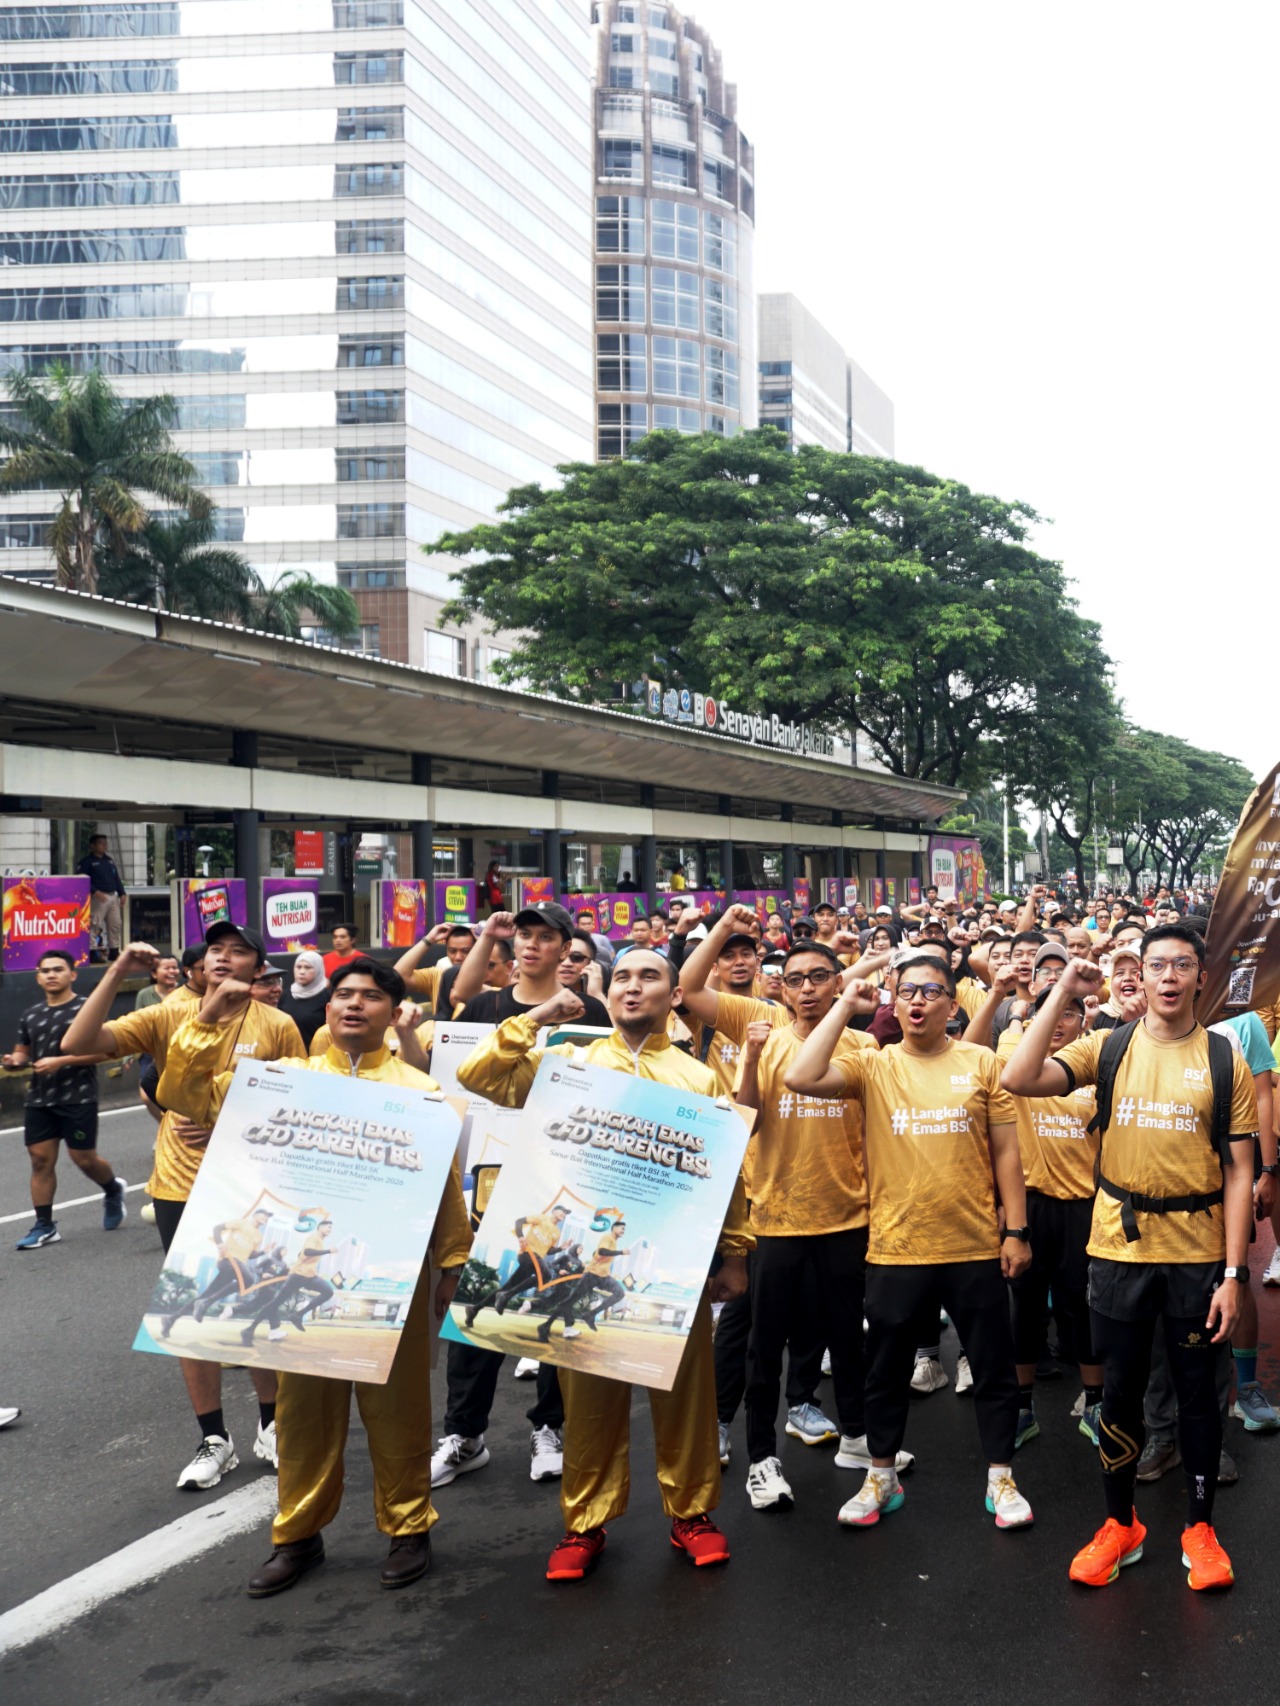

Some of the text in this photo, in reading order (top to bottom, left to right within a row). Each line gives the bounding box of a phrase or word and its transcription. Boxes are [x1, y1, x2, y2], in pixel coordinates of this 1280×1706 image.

[719, 699, 770, 743] Senayan
[771, 713, 799, 747] Bank
[799, 722, 834, 756] Jakarta
[275, 899, 308, 914] TEH BUAH
[14, 909, 76, 937] NutriSari
[271, 909, 312, 928] NUTRISARI
[234, 1042, 256, 1055] BSI
[950, 1074, 971, 1085] BSI
[1184, 1067, 1205, 1081] BSI
[383, 1100, 406, 1115] BSI
[676, 1105, 699, 1121] BSI
[796, 1106, 826, 1118] Emas
[911, 1105, 968, 1121] Langkah
[1137, 1097, 1194, 1118] Langkah
[268, 1106, 416, 1147] LANGKAH EMAS
[568, 1103, 706, 1153] LANGKAH EMAS
[911, 1120, 970, 1135] Emas BSI
[1038, 1124, 1069, 1137] Emas
[1136, 1114, 1197, 1133] Emas BSI
[241, 1121, 294, 1147] CFD
[291, 1129, 387, 1167] BARENG
[543, 1118, 593, 1144] CFD
[590, 1128, 679, 1168] BARENG
[270, 1156, 286, 1167] Bali
[285, 1159, 333, 1174] International
[332, 1166, 349, 1177] Half
[349, 1169, 385, 1183] Marathon
[279, 1151, 380, 1174] Dapatkan gratis tiket BSI 5K
[577, 1149, 671, 1180] Dapatkan gratis tiket BSI 5K
[569, 1153, 584, 1165] Bali
[583, 1157, 627, 1176] International
[627, 1168, 643, 1181] Half
[642, 1173, 675, 1189] Marathon
[674, 1181, 694, 1193] 2026
